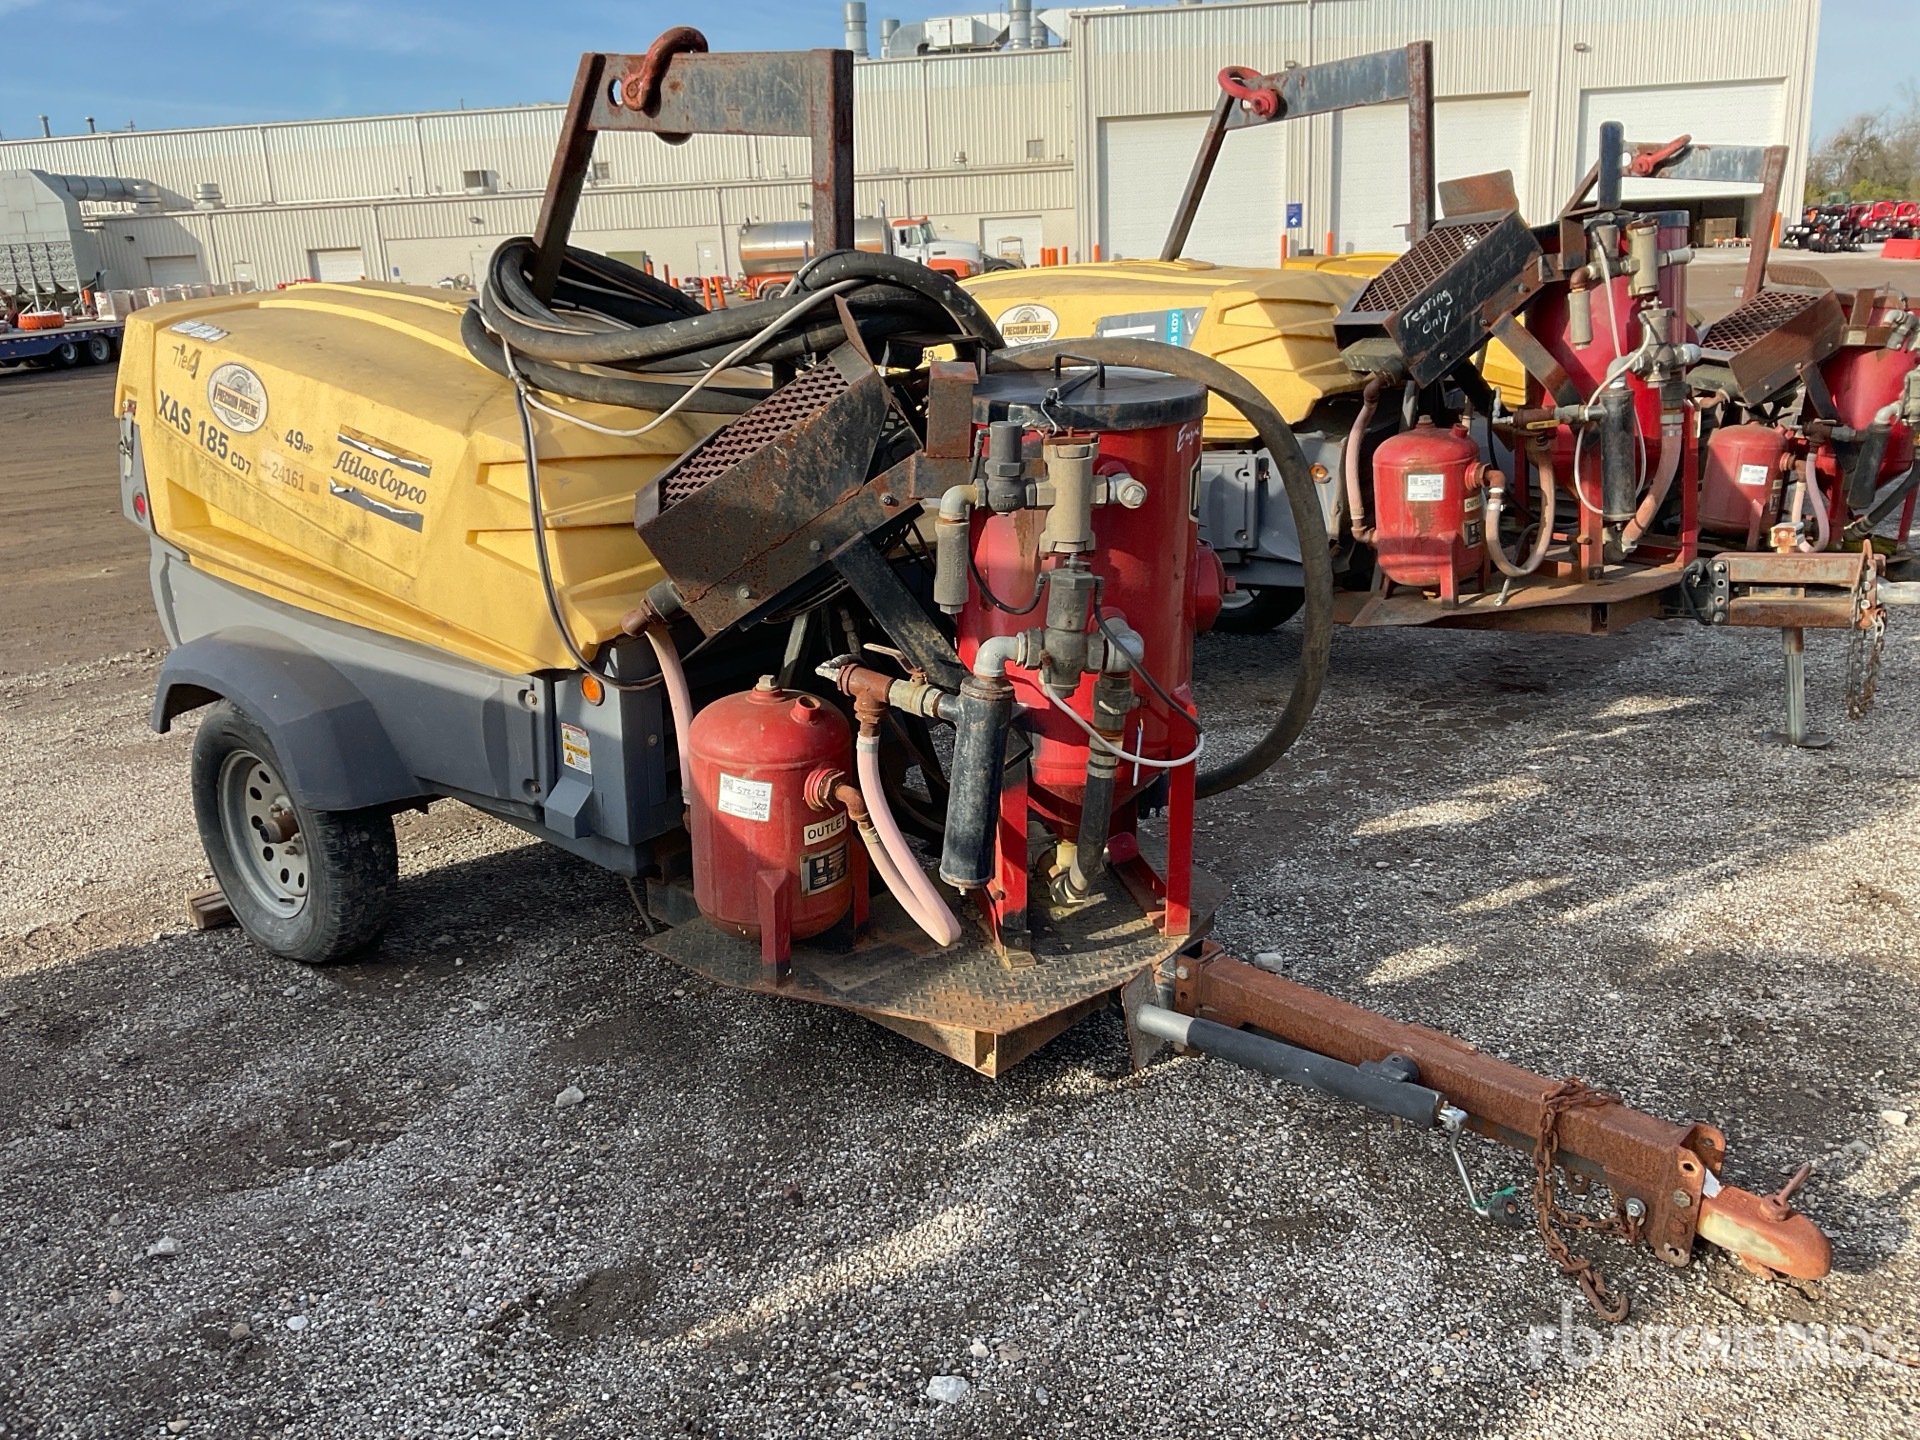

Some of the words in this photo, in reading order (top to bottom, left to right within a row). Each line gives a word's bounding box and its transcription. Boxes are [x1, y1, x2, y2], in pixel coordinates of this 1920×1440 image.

[1171, 313, 1179, 333] KD7
[216, 387, 239, 410] PRECISION
[238, 398, 258, 420] PIPELINE
[158, 389, 191, 435] XAS
[198, 420, 229, 460] 185
[230, 451, 252, 475] CD7
[332, 450, 378, 486] Atlas
[379, 468, 427, 505] Copco
[807, 814, 846, 840] OUTLET
